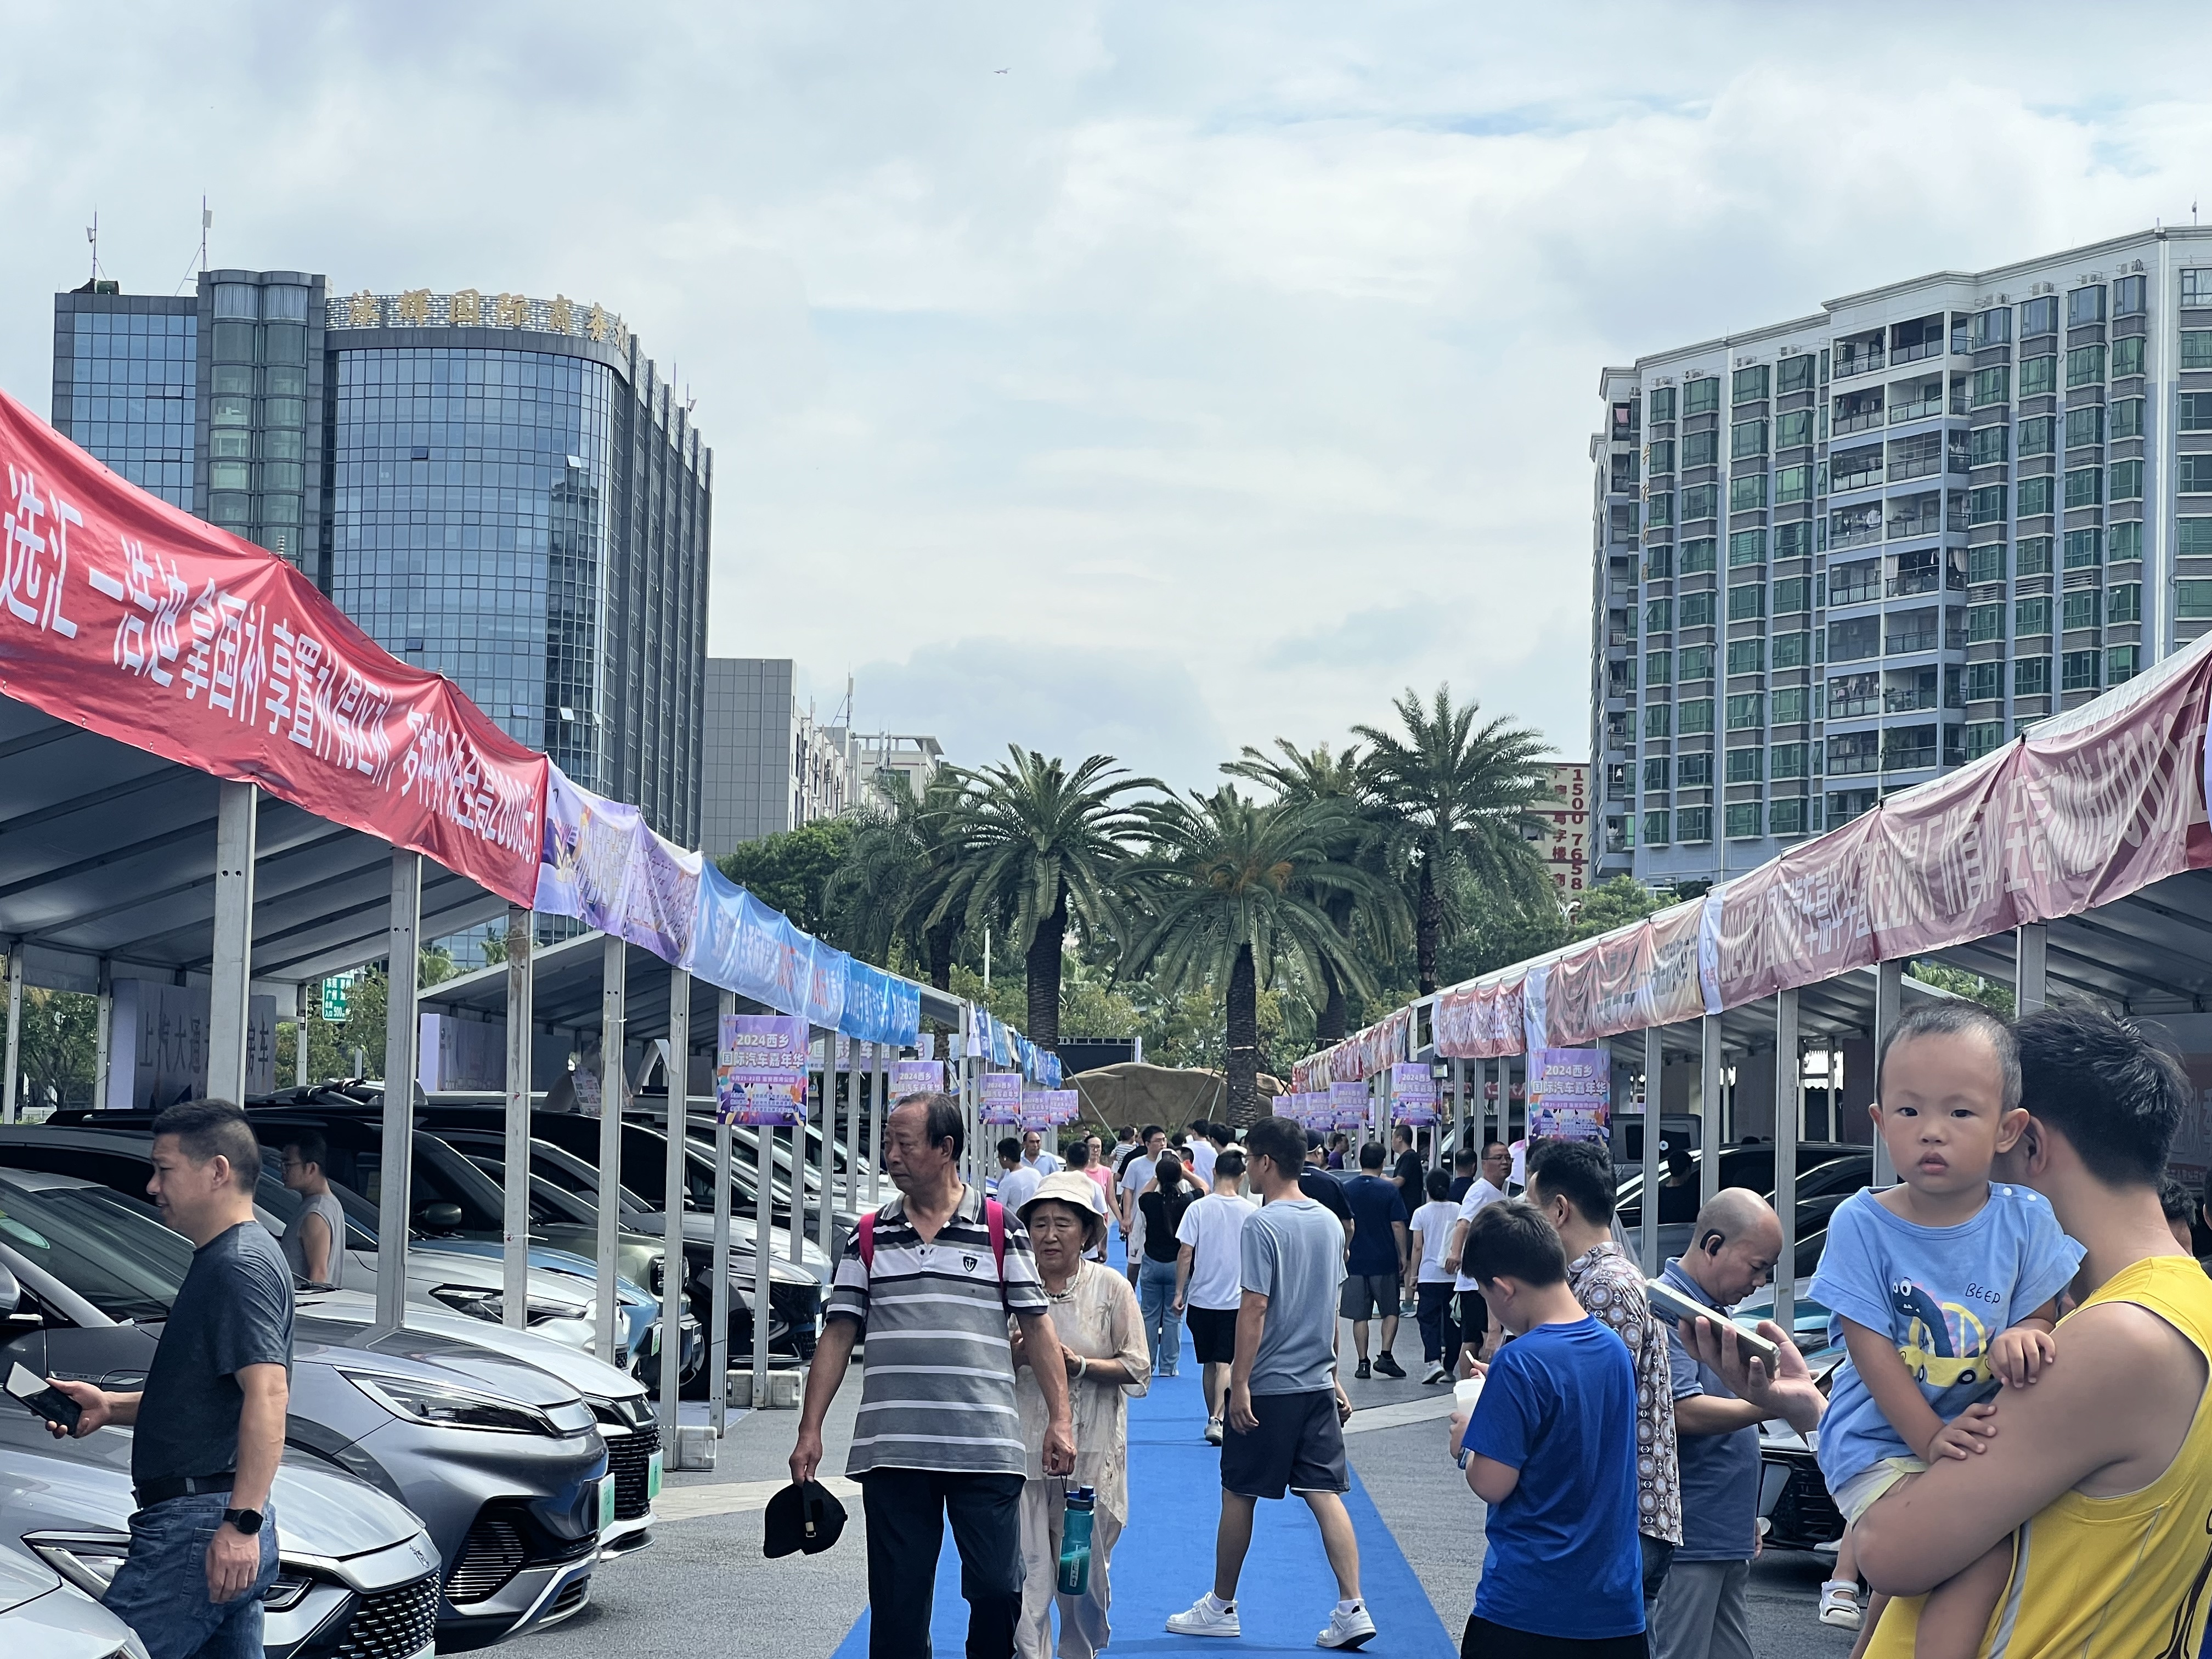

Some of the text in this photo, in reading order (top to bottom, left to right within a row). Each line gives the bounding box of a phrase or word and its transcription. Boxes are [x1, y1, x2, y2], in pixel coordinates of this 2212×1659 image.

[736, 1034, 789, 1048] 2024西乡
[722, 1051, 805, 1068] 国际汽车嘉年华
[900, 1072, 932, 1081] 2024西乡
[1546, 1065, 1593, 1077] 2024西乡
[1533, 1081, 1607, 1094] 国际汽车嘉年华
[1965, 1283, 2000, 1304] BEEP
